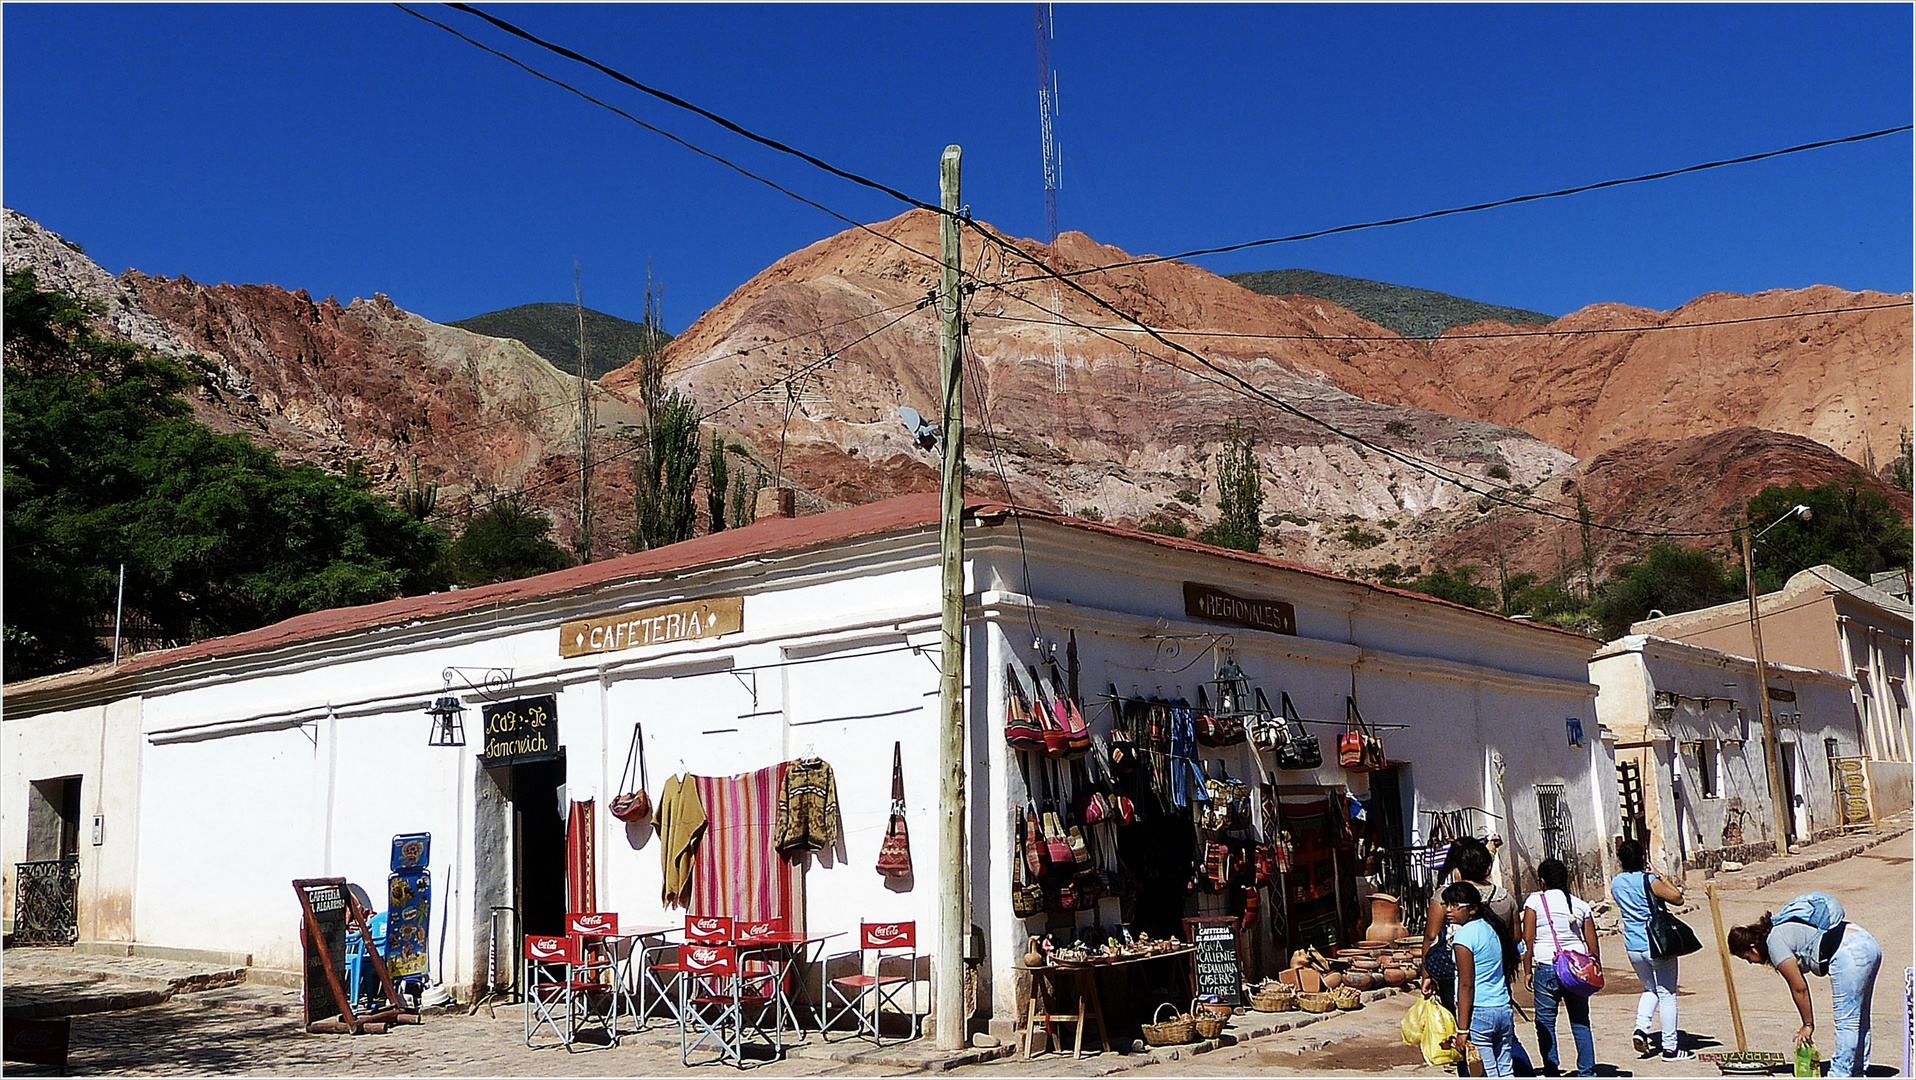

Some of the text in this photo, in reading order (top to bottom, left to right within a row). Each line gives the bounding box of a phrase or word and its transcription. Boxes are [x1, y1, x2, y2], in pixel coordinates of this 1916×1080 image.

[1206, 593, 1282, 629] REGIONALES
[590, 610, 701, 649] CAFETERIA
[309, 889, 341, 903] CAFETERIA
[1197, 941, 1223, 953] AGUA
[1199, 950, 1237, 963] CALIENTE
[1199, 972, 1236, 986] CASERAS
